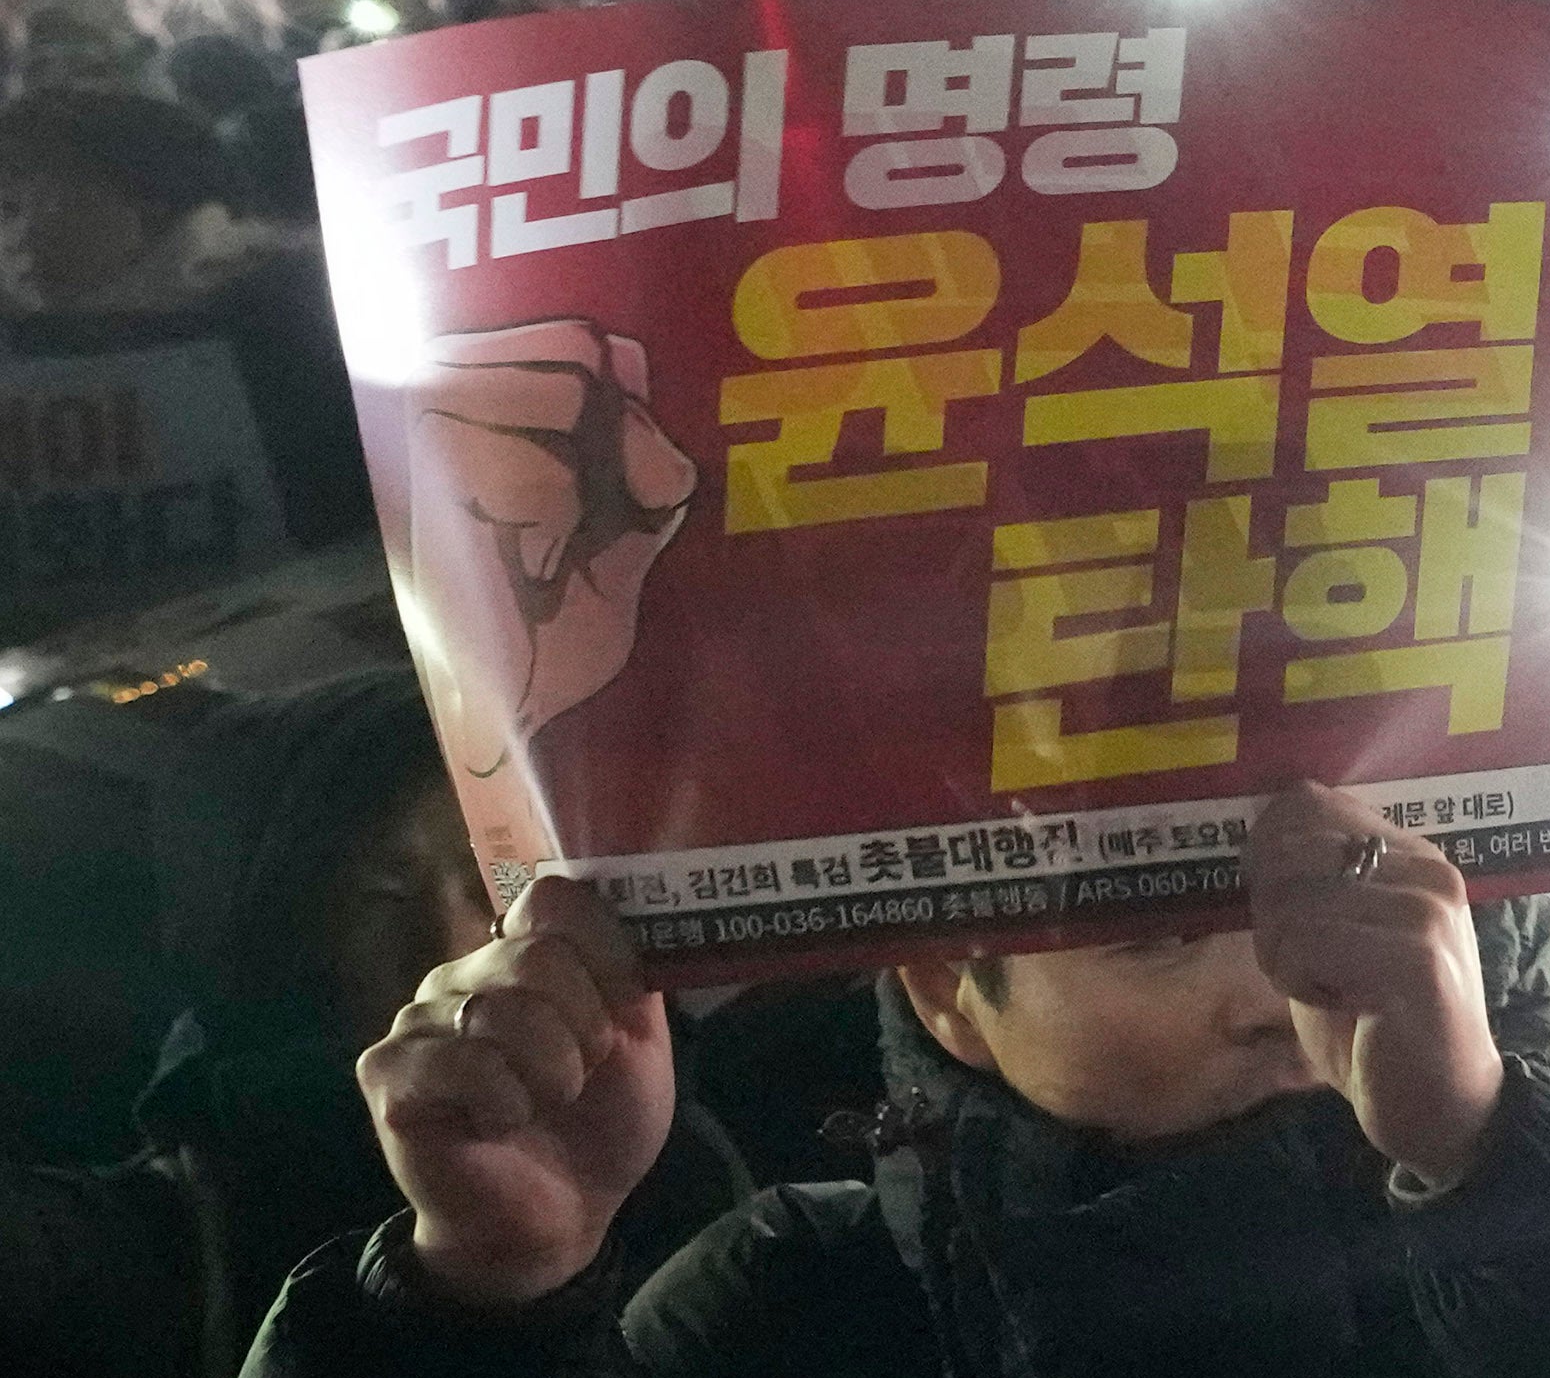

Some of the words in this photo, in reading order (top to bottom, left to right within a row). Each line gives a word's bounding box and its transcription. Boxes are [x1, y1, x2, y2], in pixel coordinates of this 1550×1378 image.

[377, 49, 789, 272] 국민의
[841, 27, 1189, 211] 명령
[718, 201, 1548, 537] 윤석열
[984, 470, 1528, 794] 탄핵
[688, 863, 783, 901] 김건희
[788, 853, 853, 889] 특검
[858, 820, 1083, 887] 촛불대행진
[1097, 822, 1163, 866] (매주
[1432, 796, 1457, 825] 앞
[1463, 789, 1515, 821] 대로)
[716, 896, 935, 943] 100-036-164860
[1076, 873, 1134, 903] ARS
[1489, 830, 1533, 859] 여러
